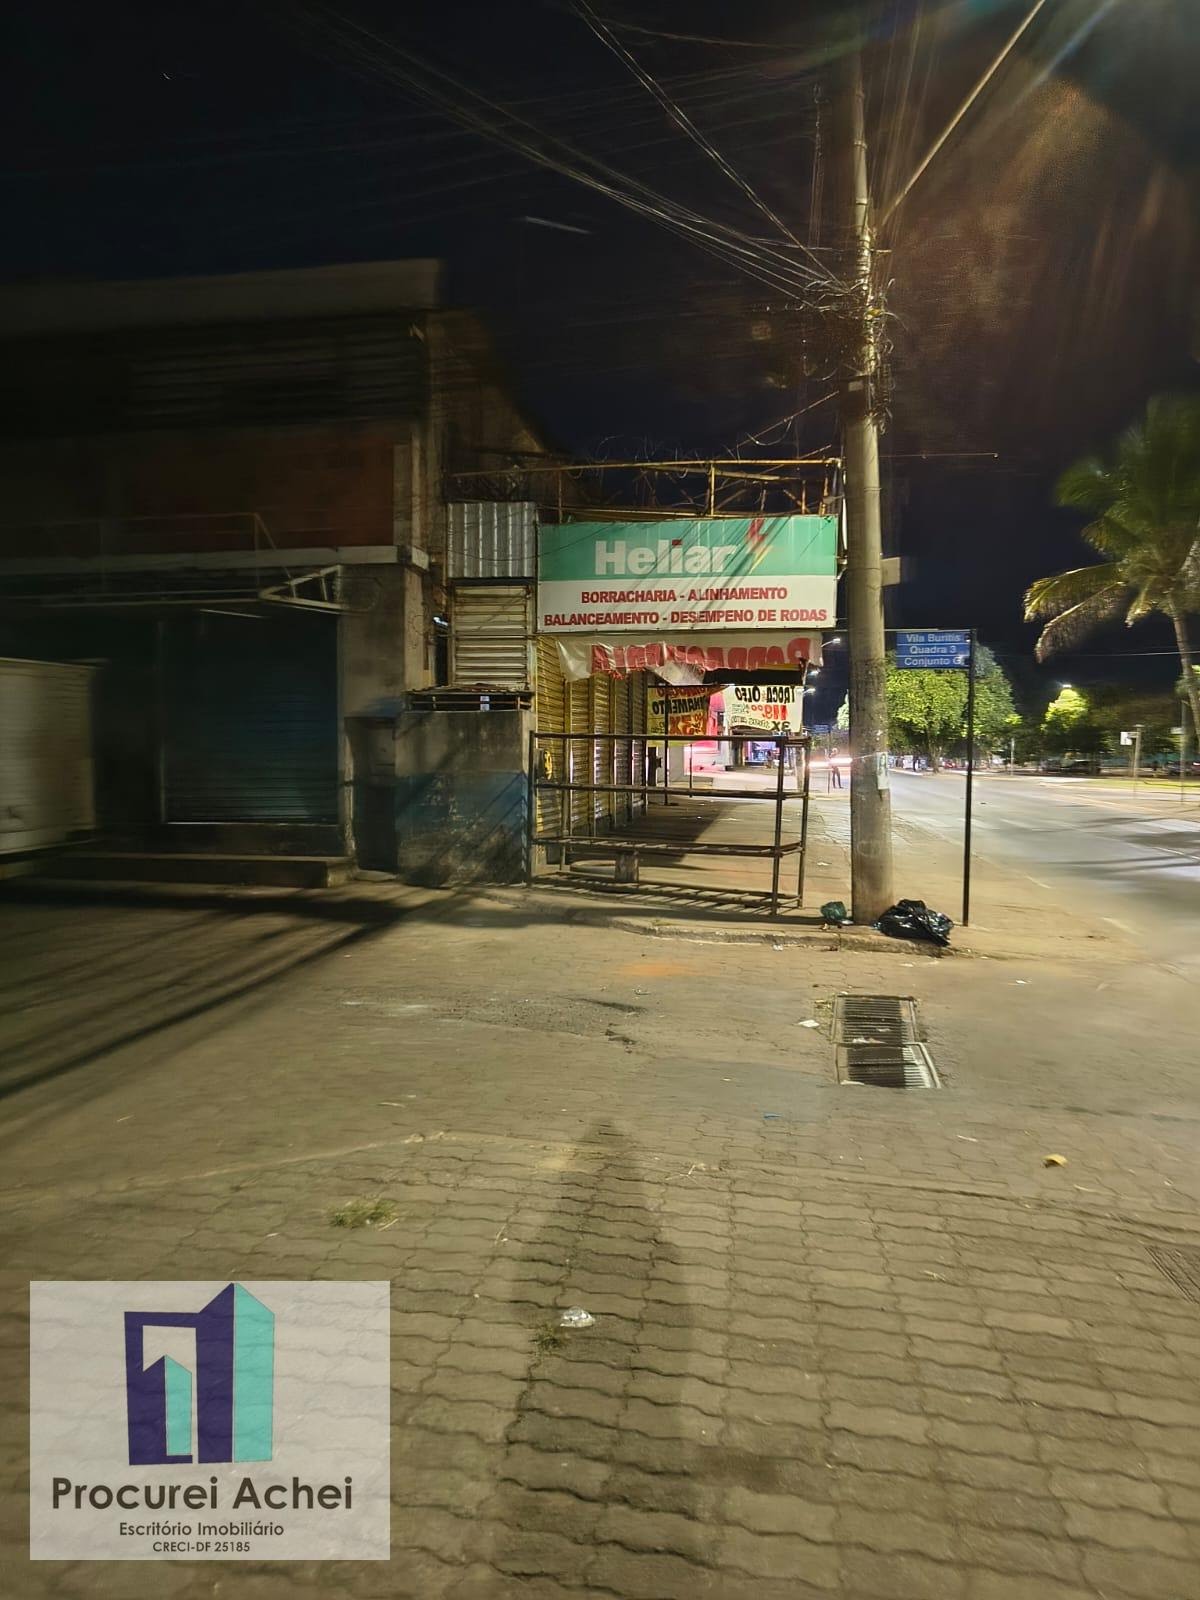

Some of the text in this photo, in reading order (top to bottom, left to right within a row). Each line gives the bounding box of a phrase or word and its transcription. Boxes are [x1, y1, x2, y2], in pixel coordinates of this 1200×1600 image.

[594, 538, 740, 575] Heliar
[581, 590, 677, 603] BORRACHARIA
[688, 587, 788, 601] ALINHAMENTO
[544, 612, 660, 626] BALANCEAMENTO
[670, 609, 754, 624] DESEMPENO
[757, 609, 776, 622] DE
[780, 609, 827, 621] RODAS
[906, 633, 961, 643] Vila Buritis
[910, 645, 957, 654] Quadra 3
[904, 657, 950, 667] Conjunto
